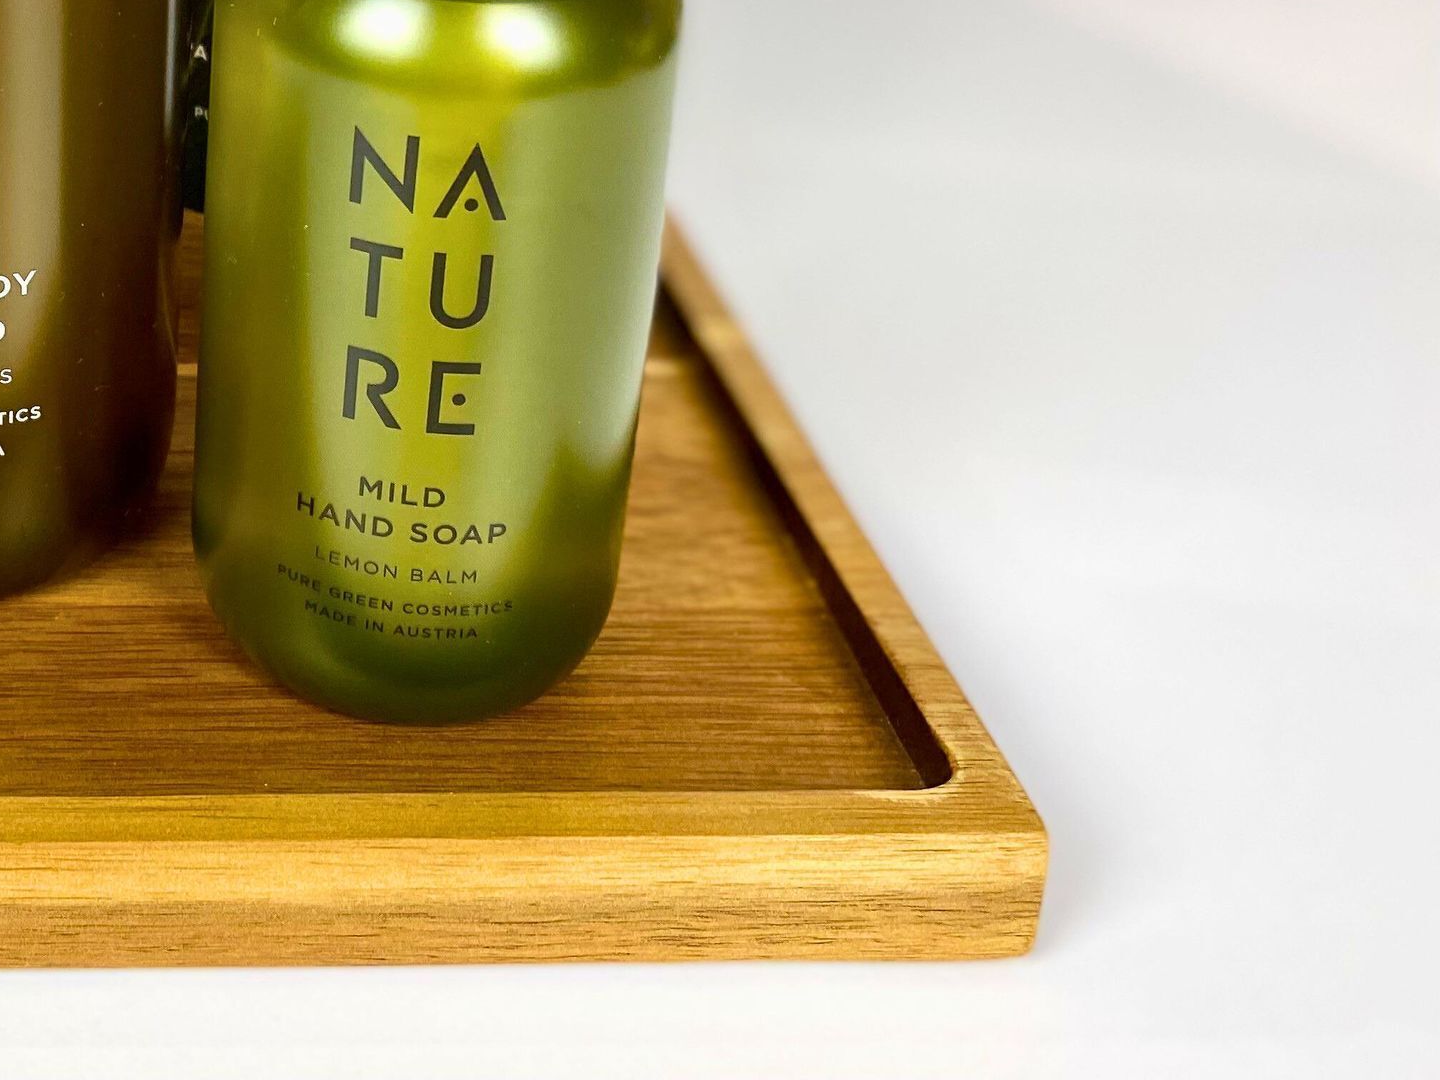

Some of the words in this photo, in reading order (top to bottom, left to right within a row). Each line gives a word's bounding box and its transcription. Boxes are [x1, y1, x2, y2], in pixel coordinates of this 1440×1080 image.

[348, 125, 507, 221] NA
[350, 237, 494, 329] TU
[342, 344, 482, 436] RE
[297, 491, 394, 538] HAND
[409, 523, 507, 545] SOAP
[359, 475, 446, 508] MILD
[277, 563, 321, 592] PURE
[328, 586, 394, 612] GREEN
[402, 599, 513, 618] COSMETICS
[314, 545, 398, 579] LEMON
[410, 567, 478, 584] BALM
[304, 599, 358, 627] MADE
[365, 619, 384, 633] IN
[393, 625, 478, 640] AUSTRIA
